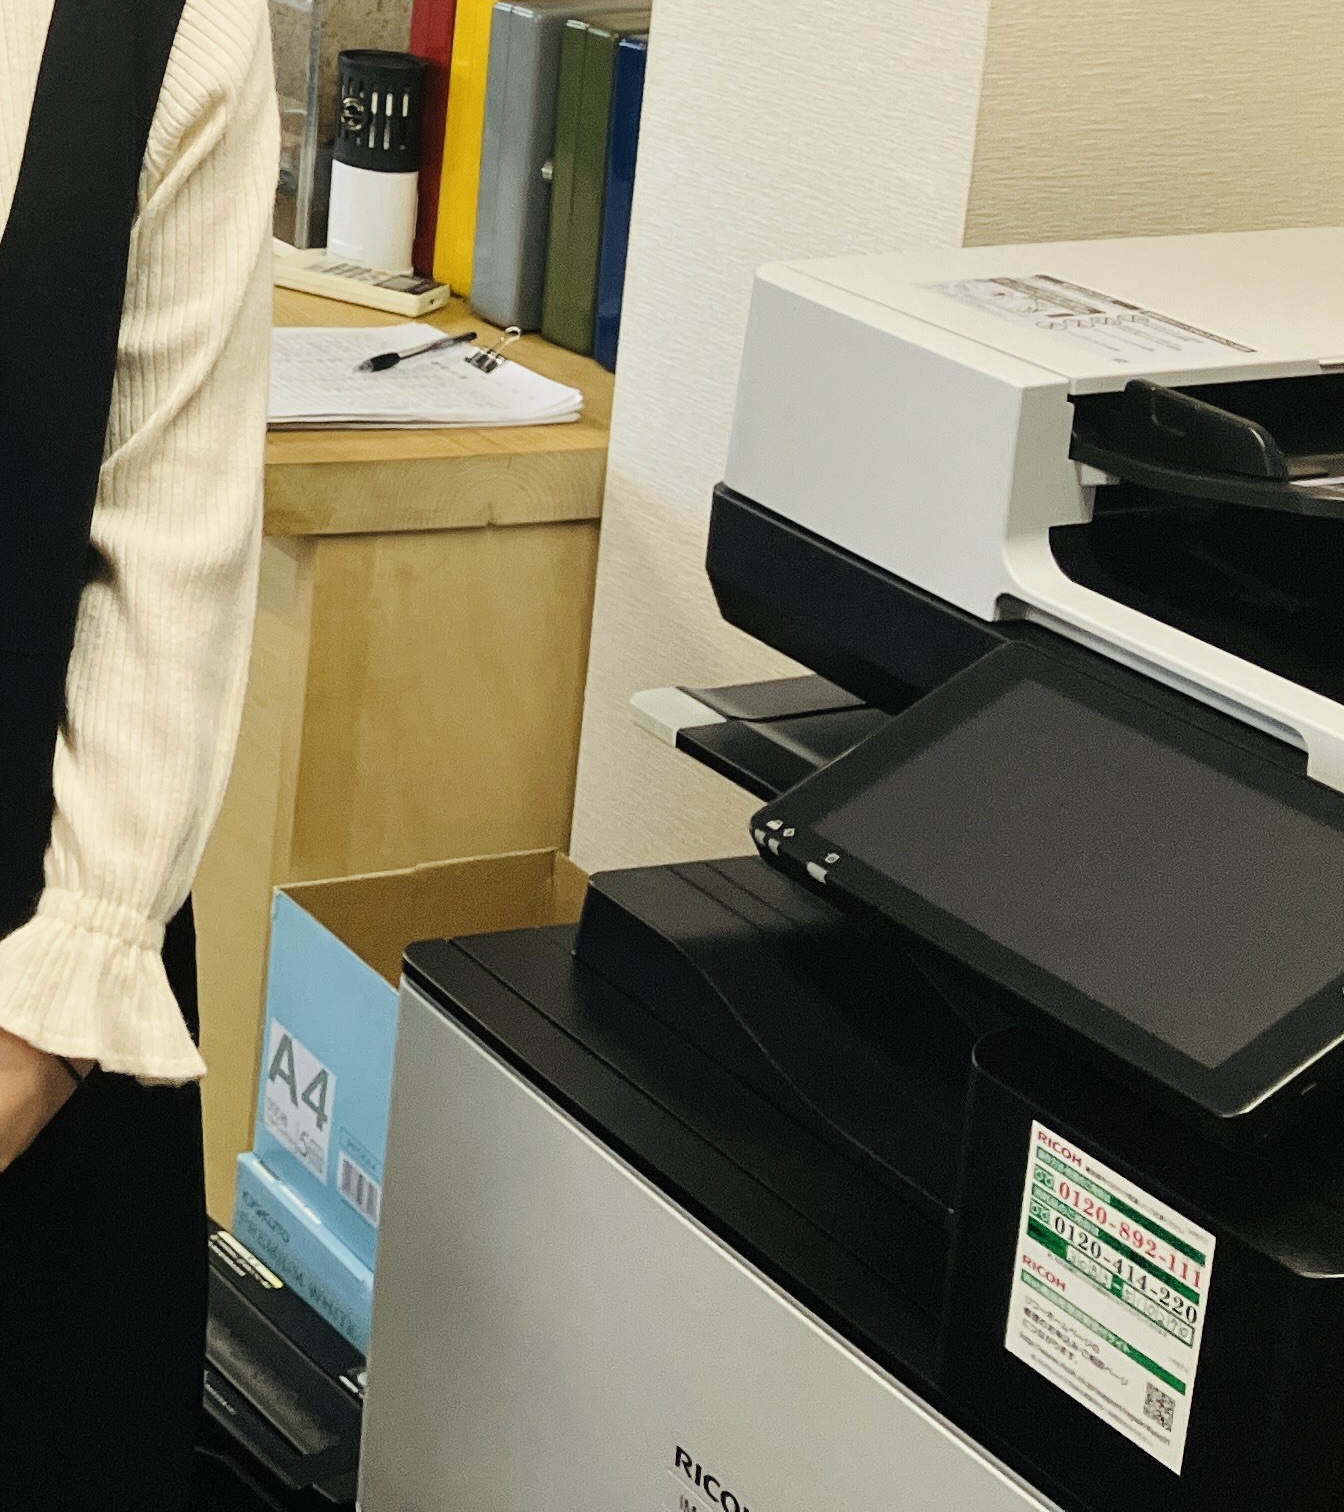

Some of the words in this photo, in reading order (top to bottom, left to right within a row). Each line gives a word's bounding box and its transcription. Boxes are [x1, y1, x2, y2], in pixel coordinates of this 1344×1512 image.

[268, 1033, 329, 1132] A4
[1038, 1131, 1083, 1168] RICOH
[1022, 1254, 1066, 1292] RICOH
[1054, 1216, 1198, 1325] 0120-414-220
[1059, 1181, 1201, 1290] 0120-892-111
[675, 1445, 749, 1512] RICO
